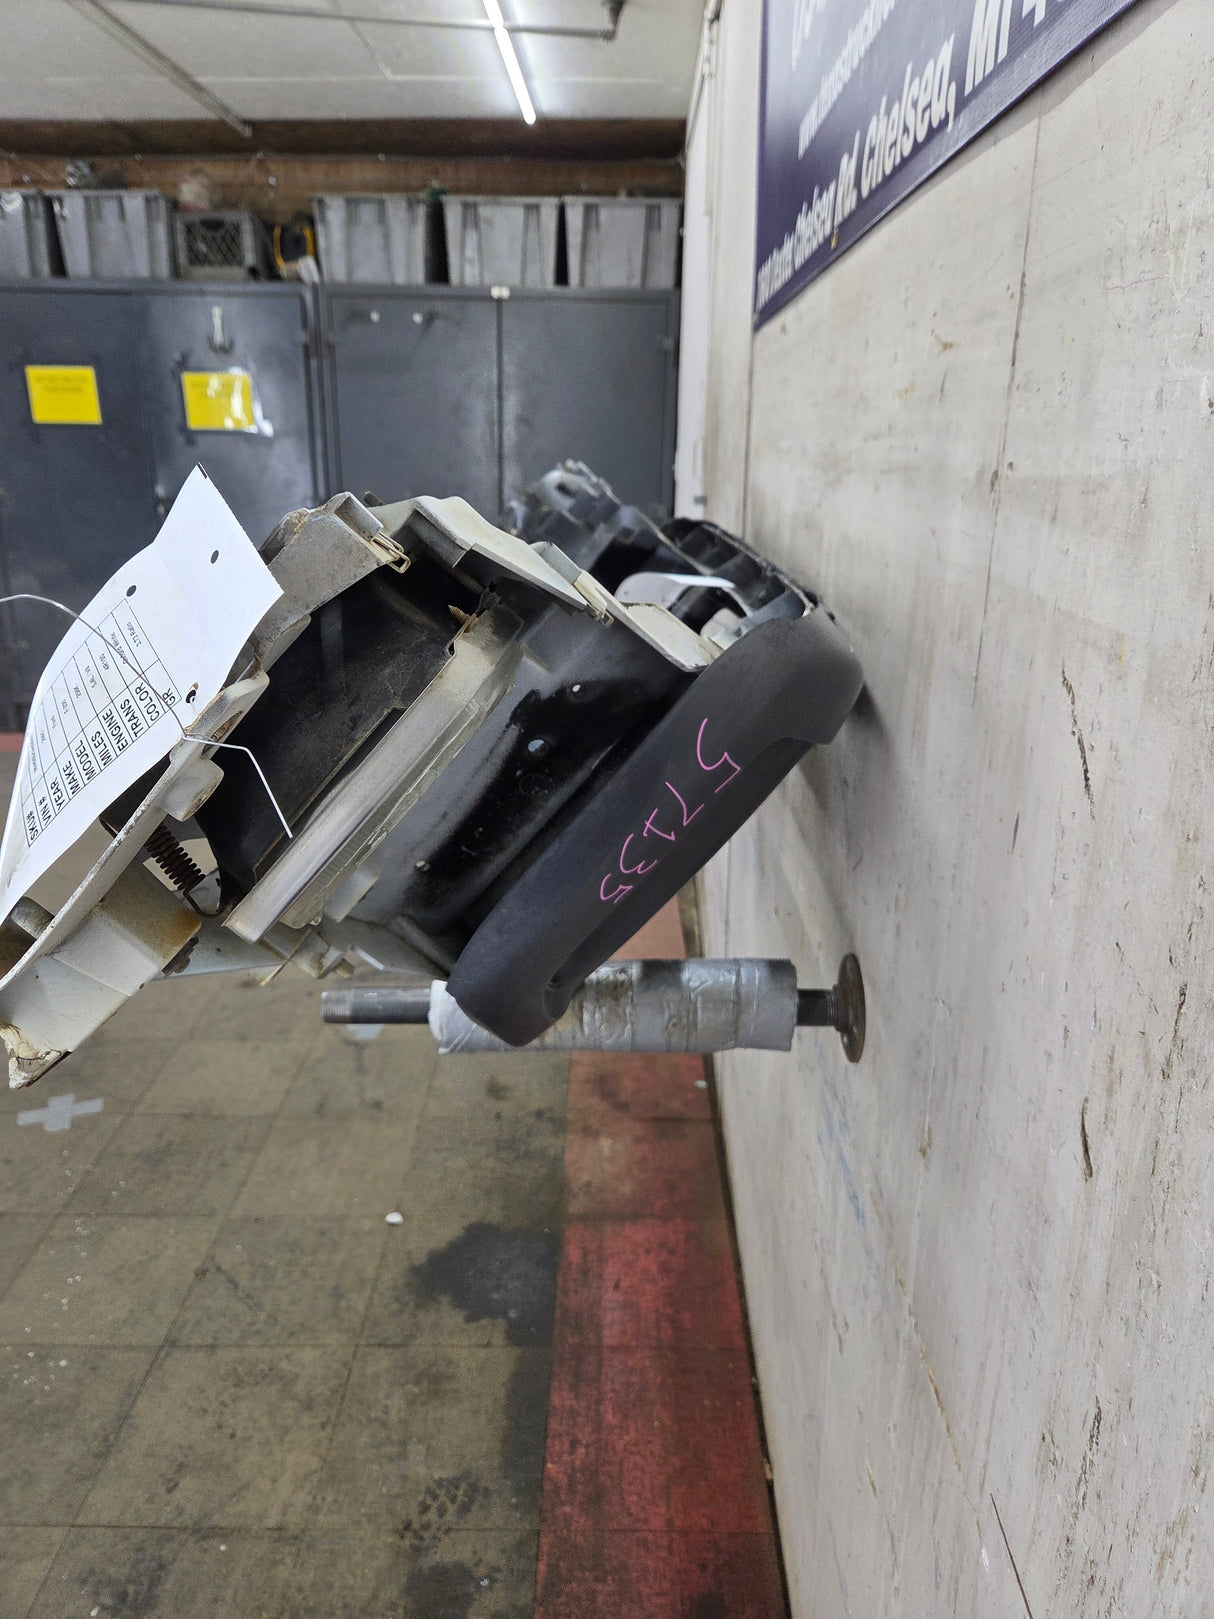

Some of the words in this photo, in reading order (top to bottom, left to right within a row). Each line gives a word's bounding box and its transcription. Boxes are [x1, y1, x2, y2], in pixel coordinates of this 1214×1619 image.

[795, 178, 836, 271] Chelsea
[861, 34, 957, 199] Chelsea,
[964, 0, 1013, 97] MI
[134, 682, 160, 722] COLOR
[162, 688, 176, 707] GR
[102, 709, 129, 752] ENGINE
[120, 699, 144, 737] TRANS
[75, 739, 97, 781] MODEL
[91, 731, 113, 767] MILES
[50, 777, 65, 811] YEAR
[62, 760, 81, 795] MAKE
[26, 809, 39, 841] SKU#
[39, 805, 52, 826] VIN
